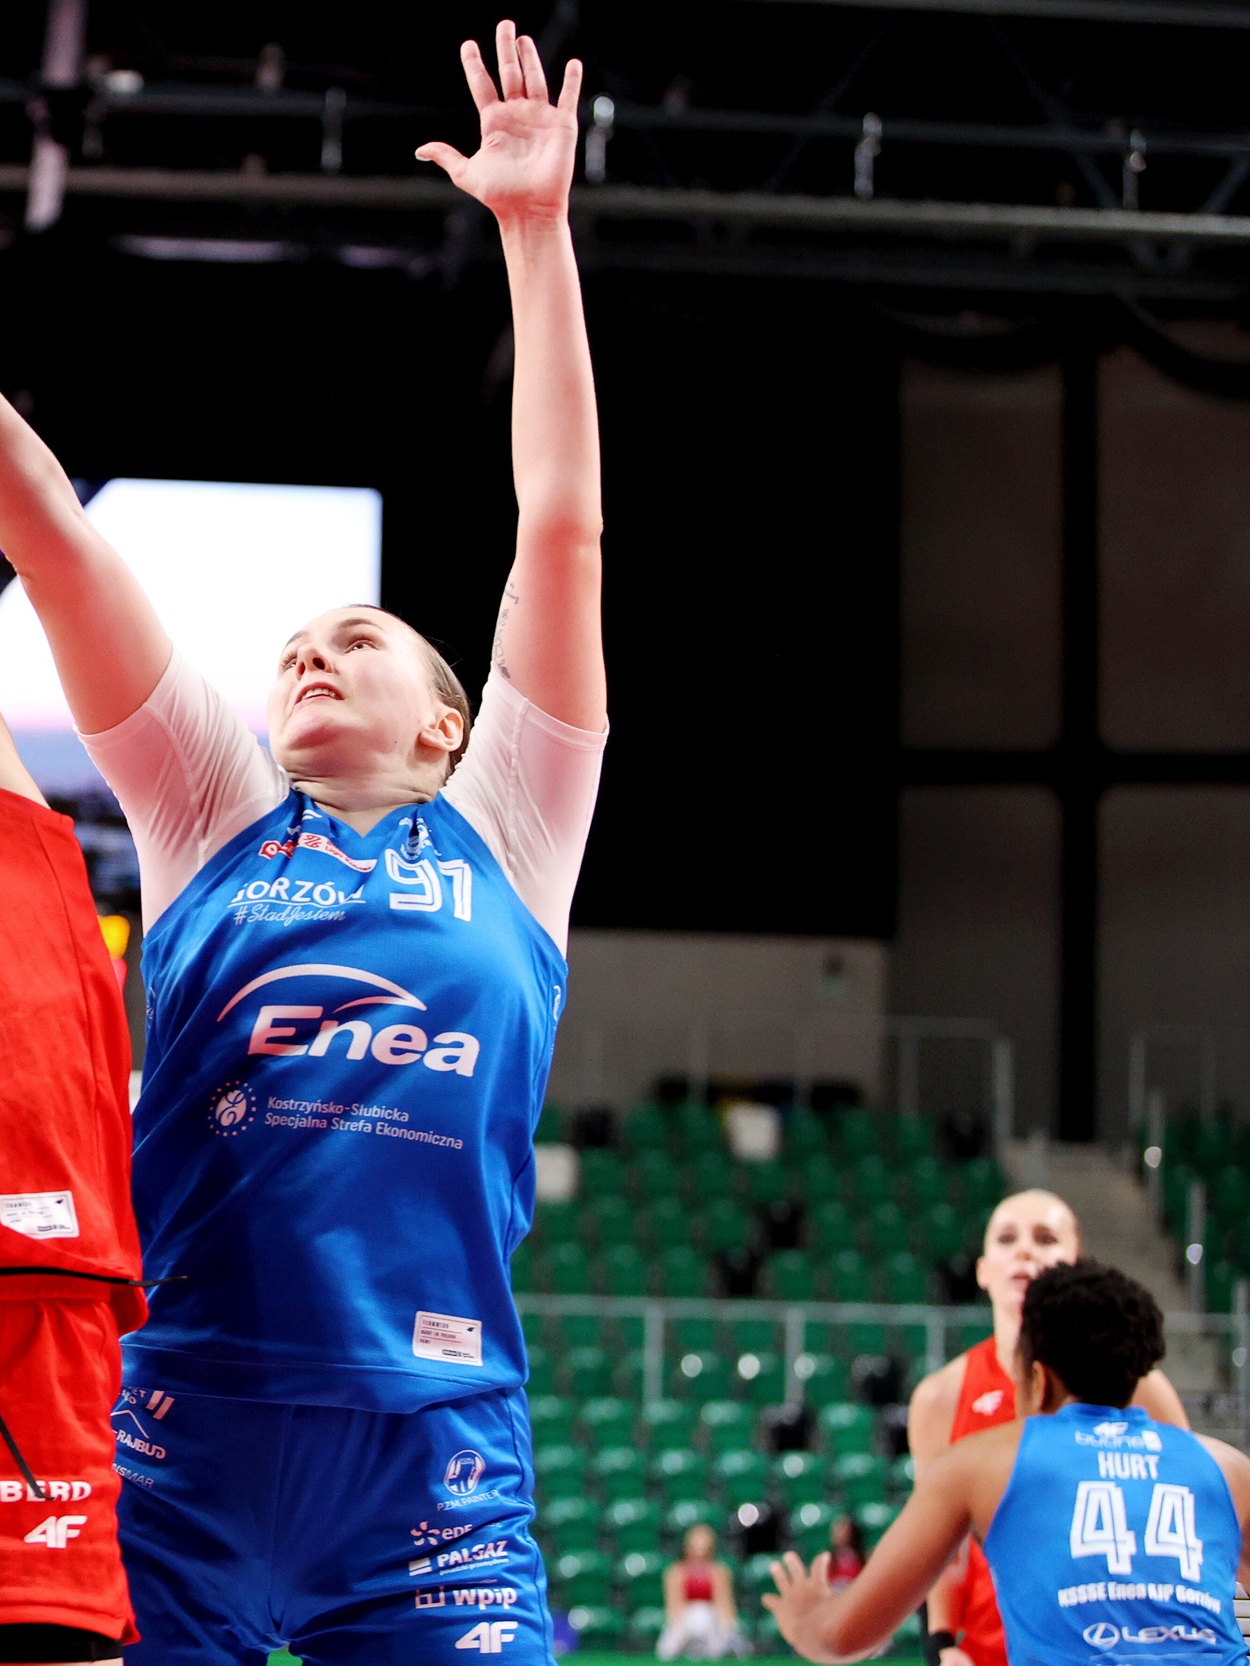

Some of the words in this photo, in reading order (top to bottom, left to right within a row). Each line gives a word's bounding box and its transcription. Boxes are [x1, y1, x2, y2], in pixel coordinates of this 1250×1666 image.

[385, 848, 472, 922] 91
[248, 1005, 481, 1077] Enea
[268, 1096, 409, 1122] Kostrzyńsko-Słubicka
[265, 1112, 328, 1129] Specjalna
[330, 1117, 372, 1133] Strefa
[375, 1121, 464, 1150] Ekonomiczna
[1098, 1451, 1160, 1480] HURT
[24, 1515, 88, 1549] 4F
[1069, 1480, 1203, 1583] 44
[452, 1587, 517, 1610] wpip
[454, 1621, 519, 1654] 4F
[1121, 1625, 1217, 1646] LEXUS
